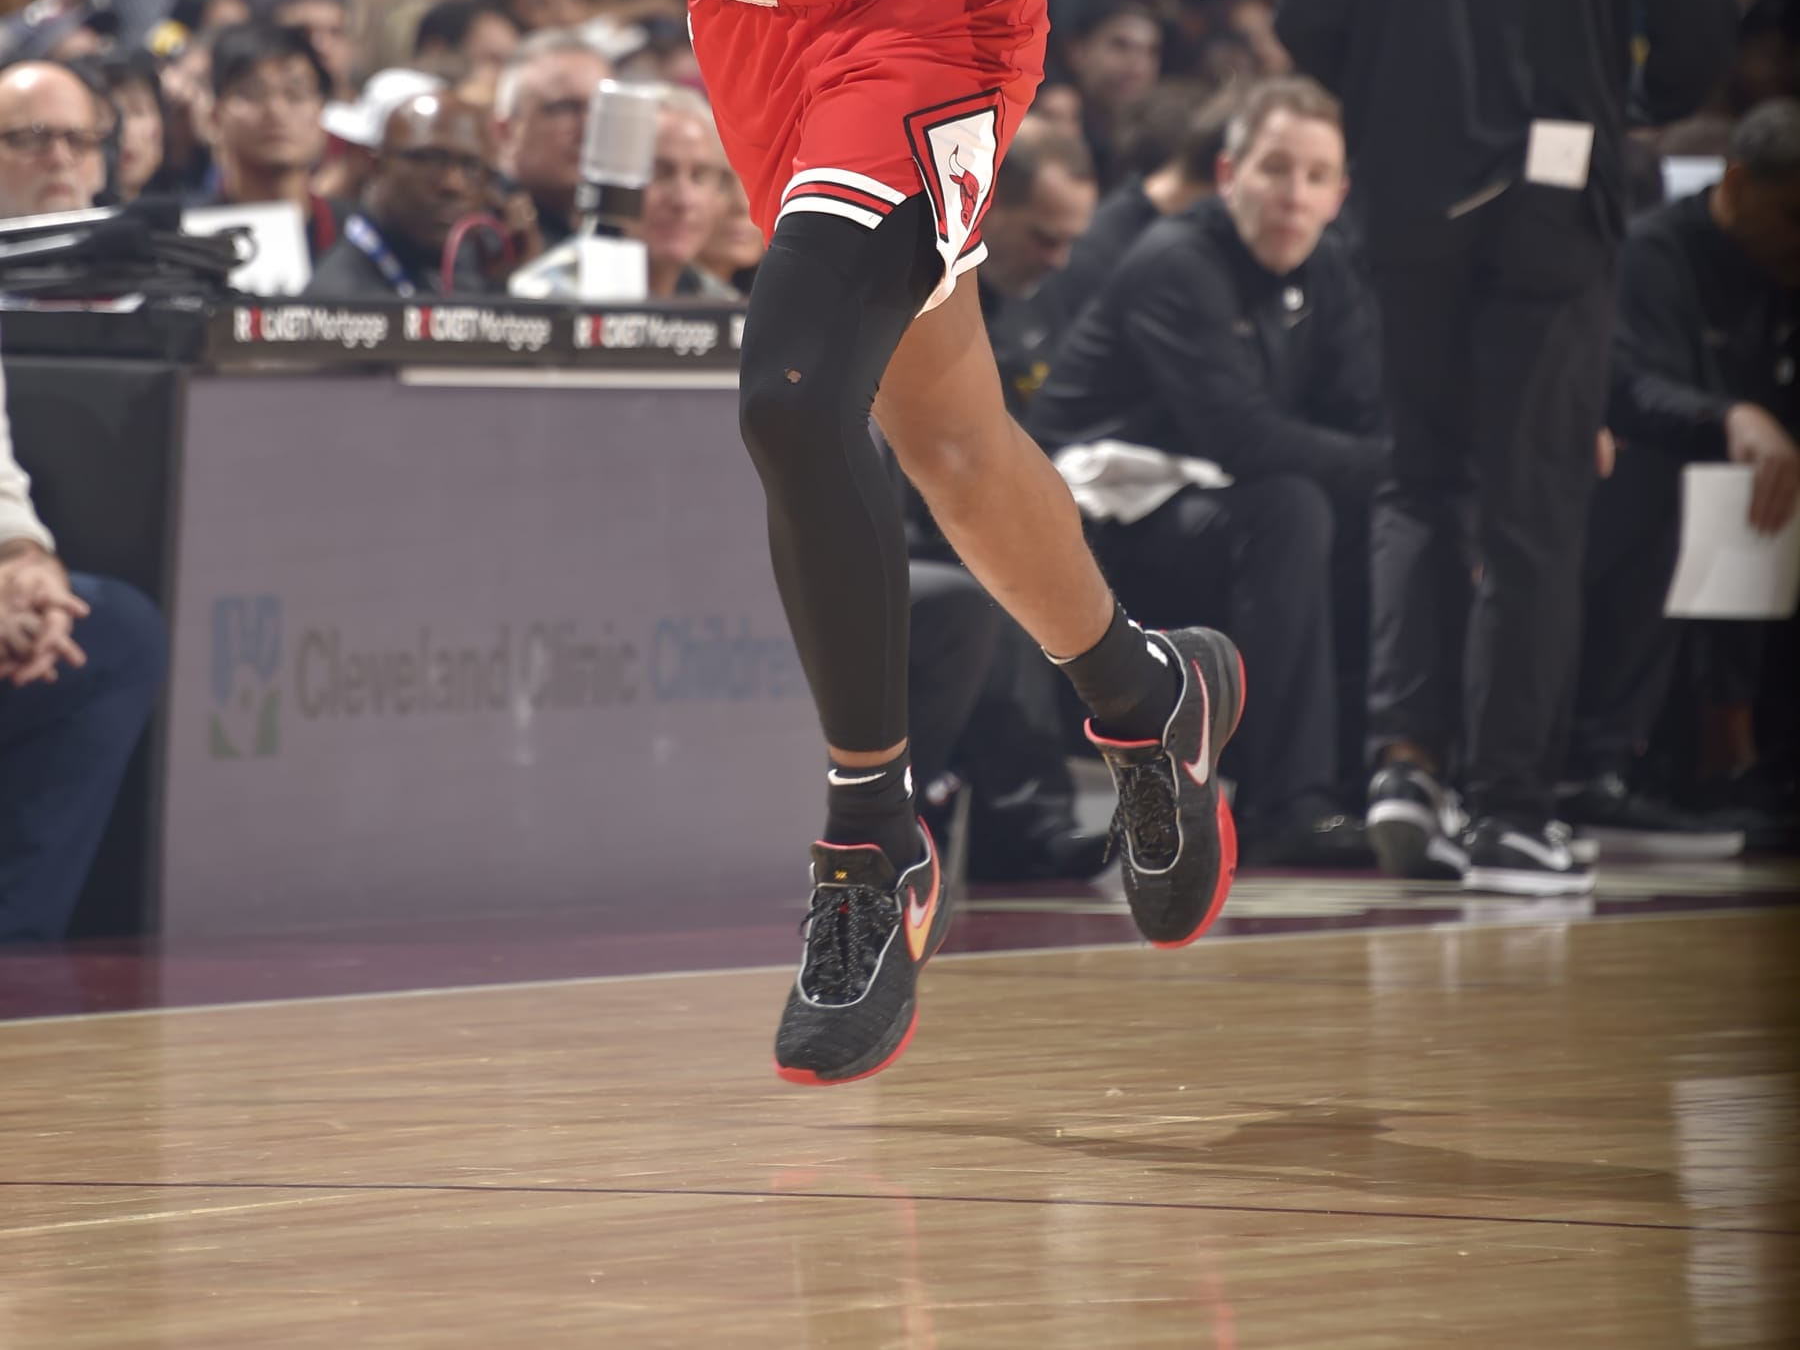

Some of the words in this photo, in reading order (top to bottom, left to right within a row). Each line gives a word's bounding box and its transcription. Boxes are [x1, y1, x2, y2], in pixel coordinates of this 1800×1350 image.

[311, 307, 388, 349] Mortgage
[479, 310, 552, 352] Mortgage
[648, 316, 718, 357] Mortgage
[293, 620, 511, 719] Cleveland
[520, 617, 639, 710] Clinic
